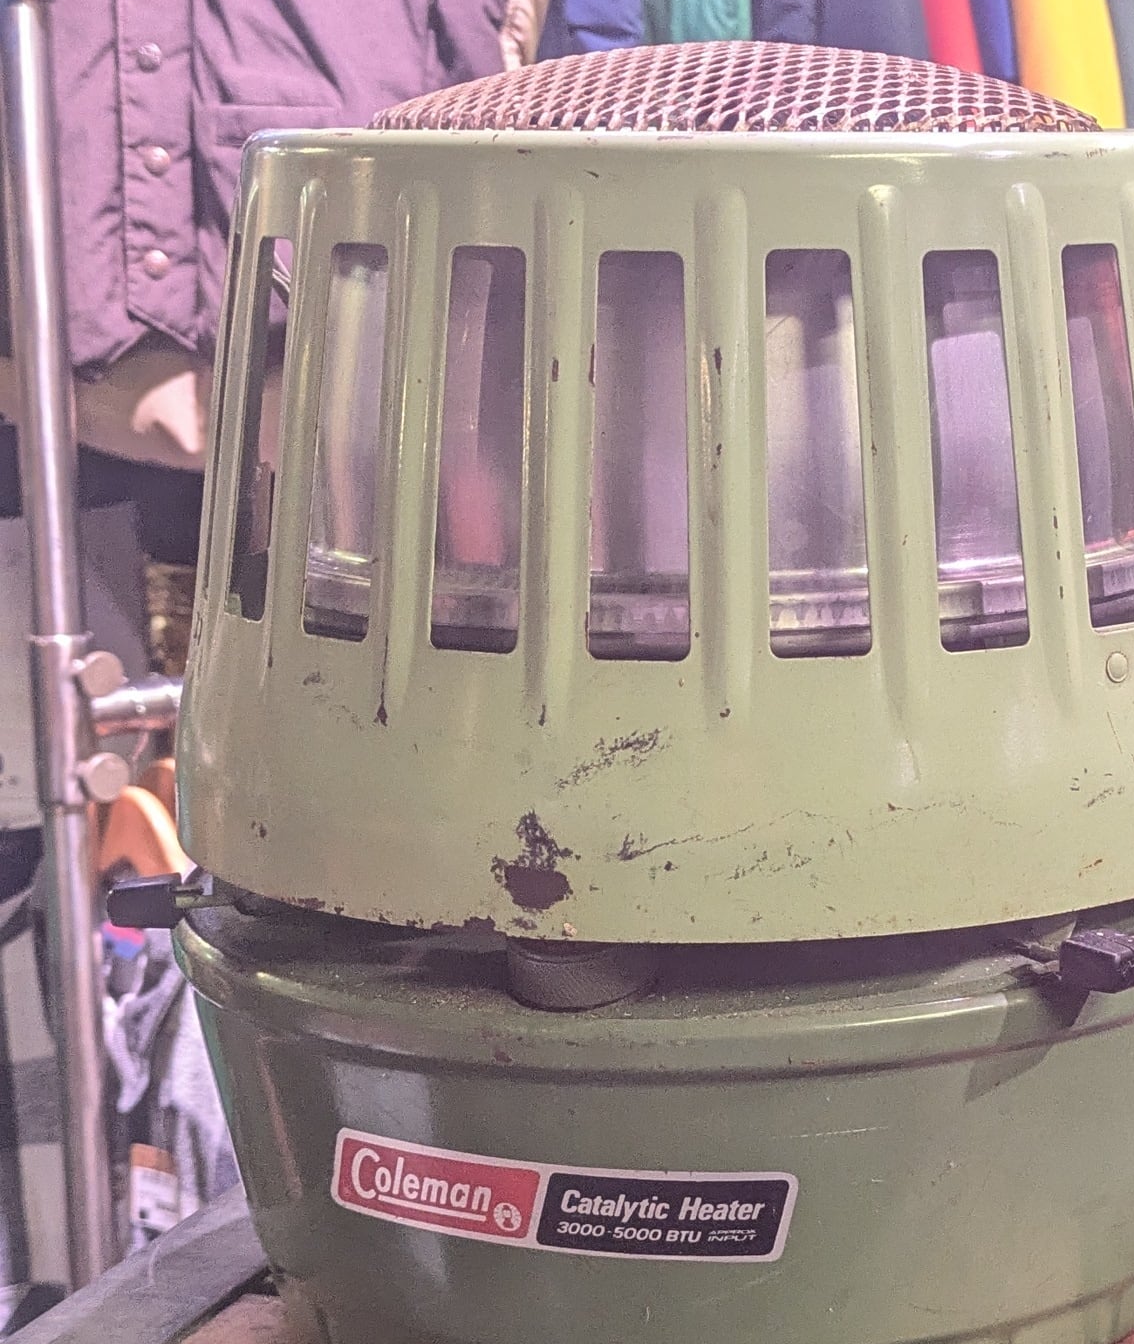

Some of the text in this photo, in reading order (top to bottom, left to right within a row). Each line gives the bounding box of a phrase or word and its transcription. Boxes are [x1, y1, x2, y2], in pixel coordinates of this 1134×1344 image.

[351, 1147, 493, 1213] Coleman
[560, 1188, 766, 1224] Catalytic Heater
[665, 1230, 702, 1244] BTU
[707, 1234, 757, 1243] INPUT
